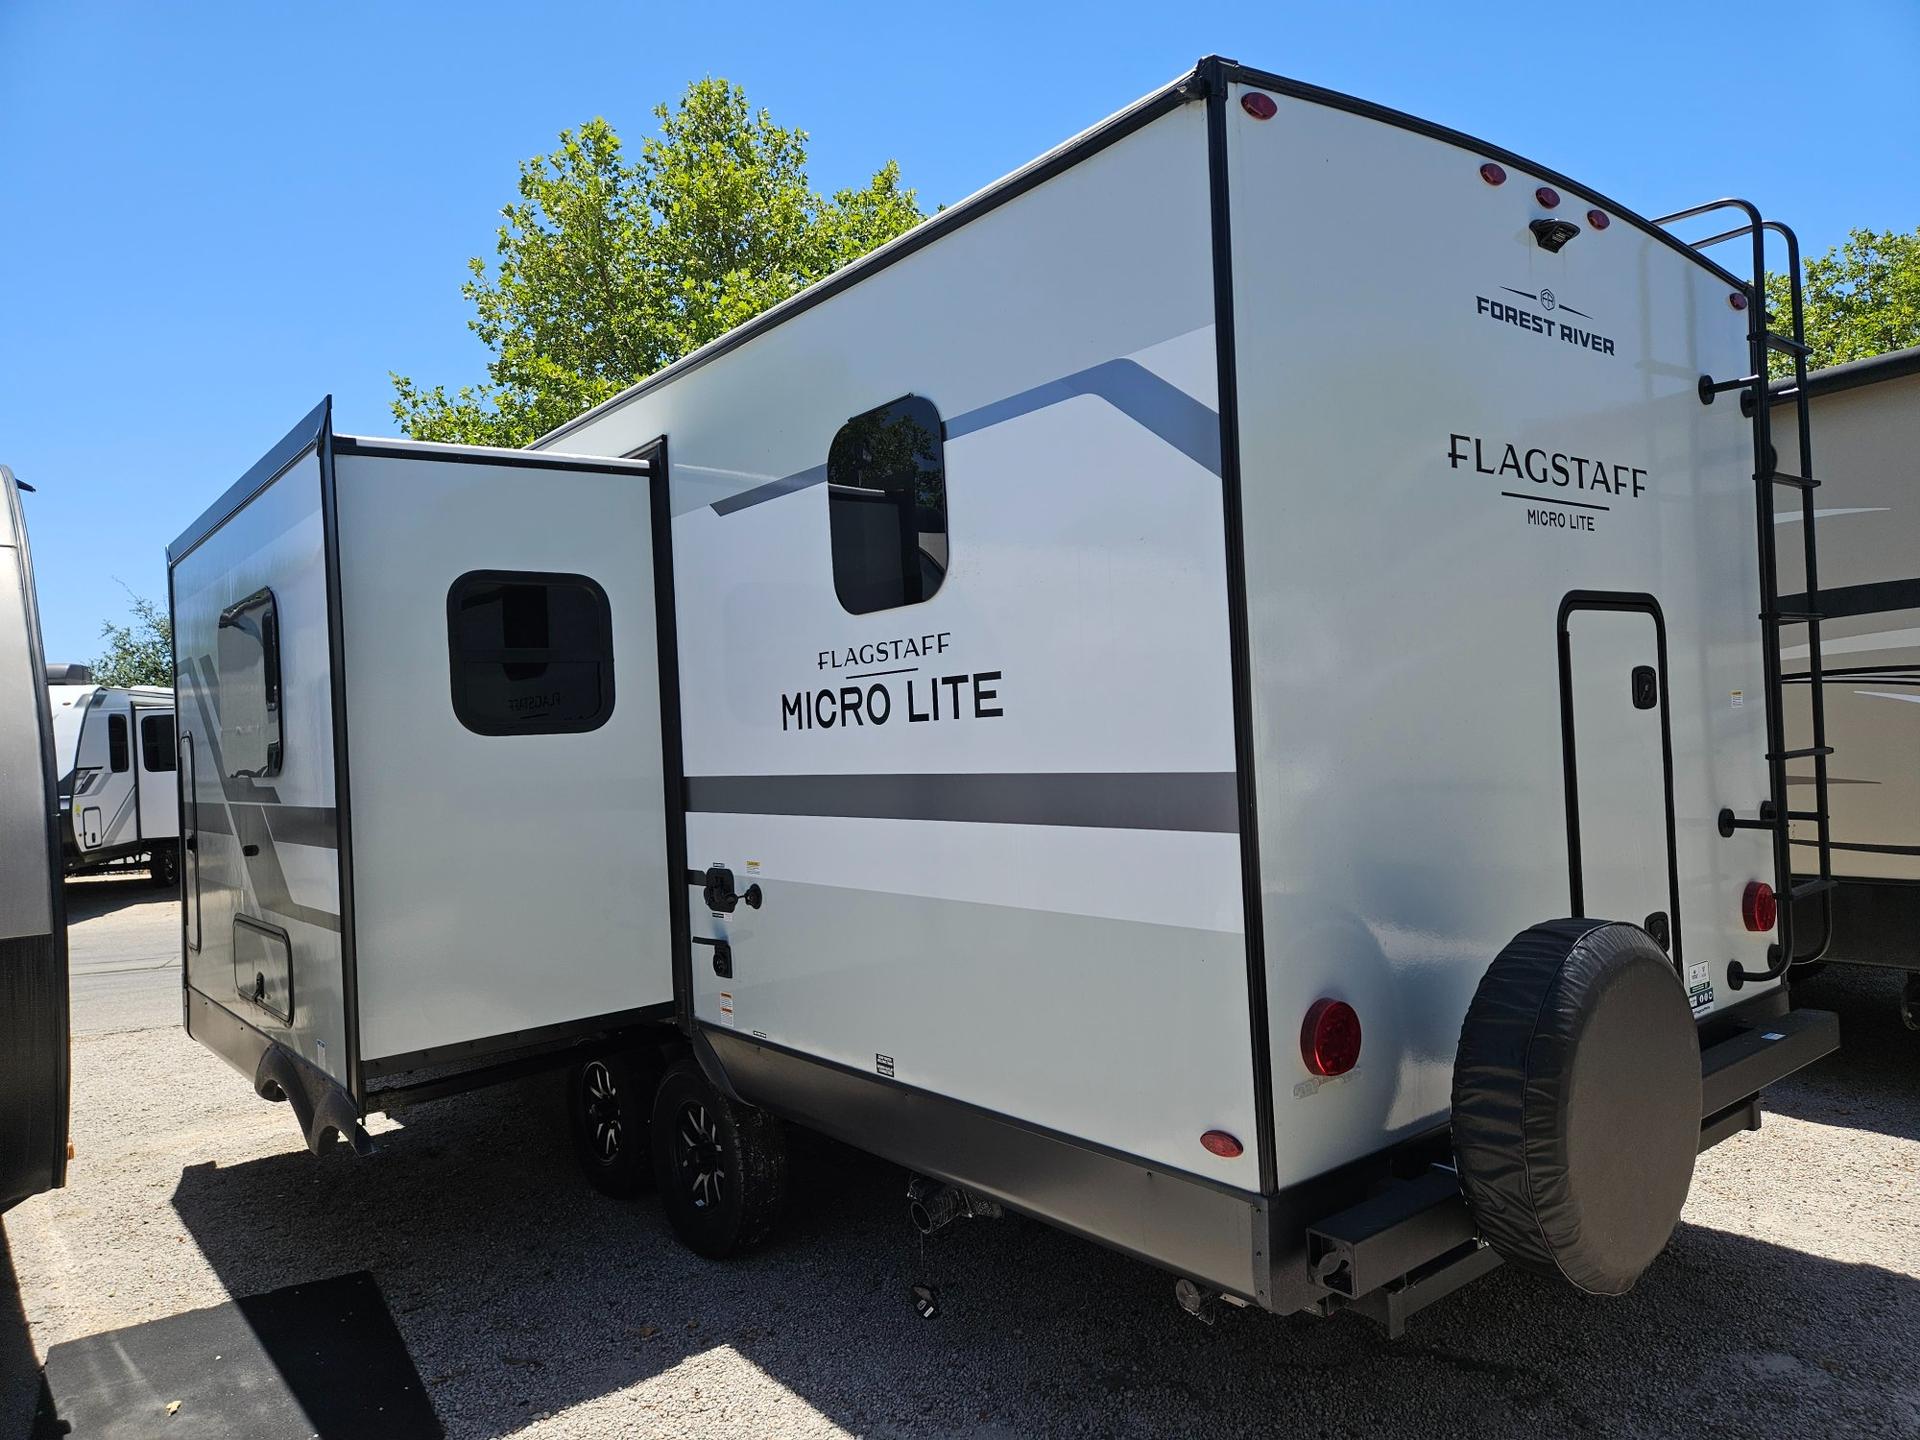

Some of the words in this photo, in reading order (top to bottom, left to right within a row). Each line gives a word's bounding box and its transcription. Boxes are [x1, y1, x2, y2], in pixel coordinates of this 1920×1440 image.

[1475, 295, 1556, 337] FOREST
[1559, 323, 1615, 356] RIVER
[1447, 433, 1648, 498] FLAGSTAFF
[1527, 508, 1566, 529] MICRO
[1569, 512, 1596, 532] LITE
[817, 632, 951, 670] FLAGSTAFF
[781, 683, 891, 731] MICRO
[907, 670, 1004, 723] LITE
